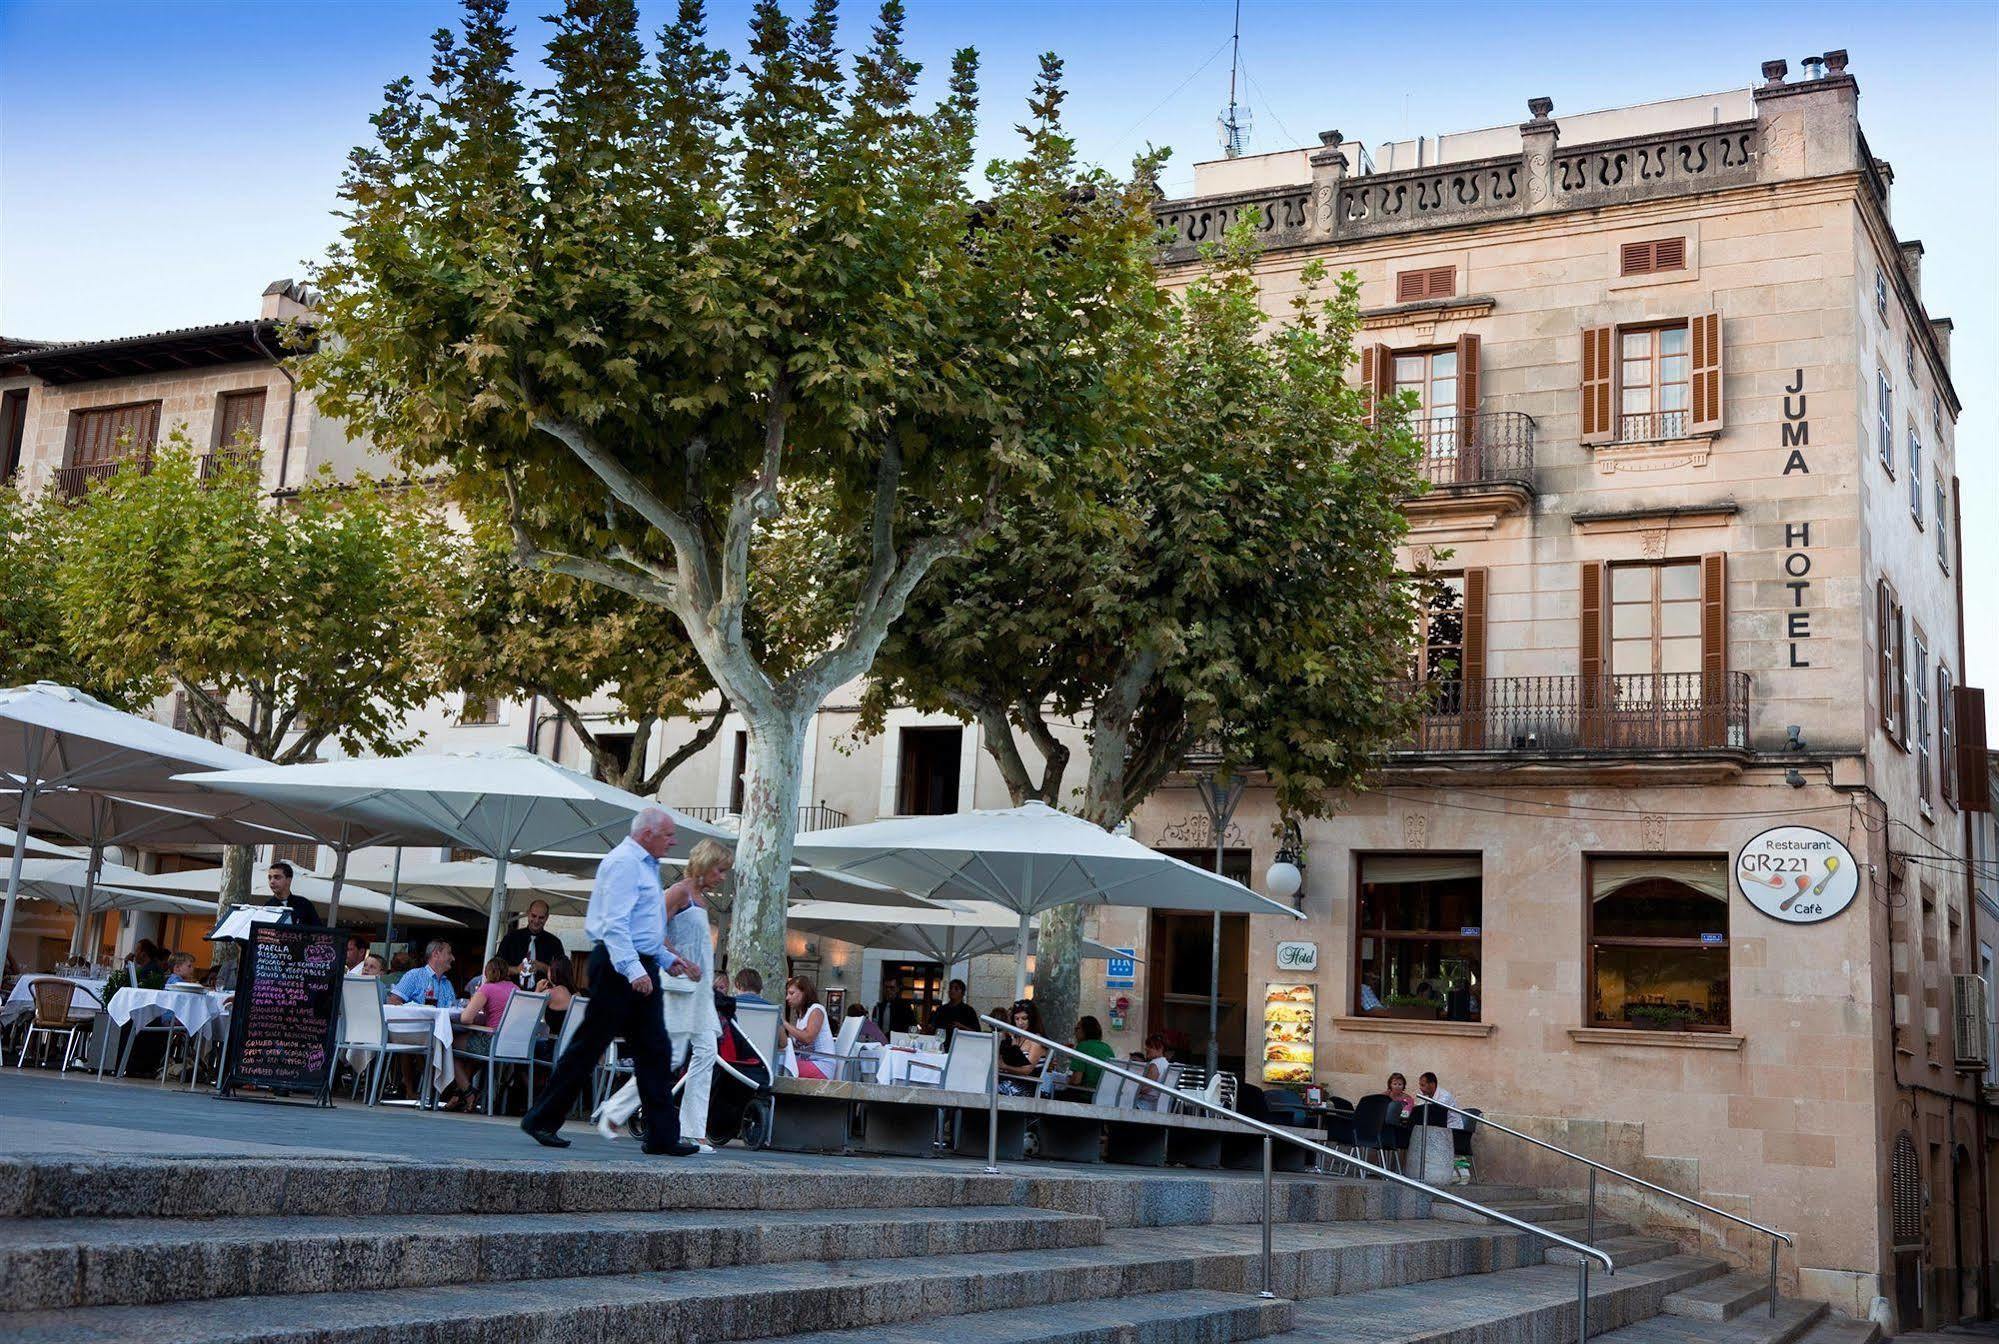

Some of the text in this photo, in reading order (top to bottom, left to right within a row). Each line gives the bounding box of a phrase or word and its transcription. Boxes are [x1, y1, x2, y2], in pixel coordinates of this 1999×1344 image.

[1782, 369, 1811, 668] JUMA HOTEL
[1766, 840, 1831, 850] Restaurant
[1741, 853, 1808, 872] GR221
[1794, 903, 1822, 914] Cafè
[257, 943, 290, 953] PAELLA
[256, 951, 293, 961] RISSOTTO
[1279, 945, 1315, 966] Hotel
[257, 958, 286, 966] AVOCADO
[256, 964, 282, 972] GRILLED
[281, 973, 305, 981] RINGS
[253, 985, 305, 995] SEAFOOD SALAD
[308, 983, 329, 991] SALAD
[289, 993, 309, 1001] SALAD
